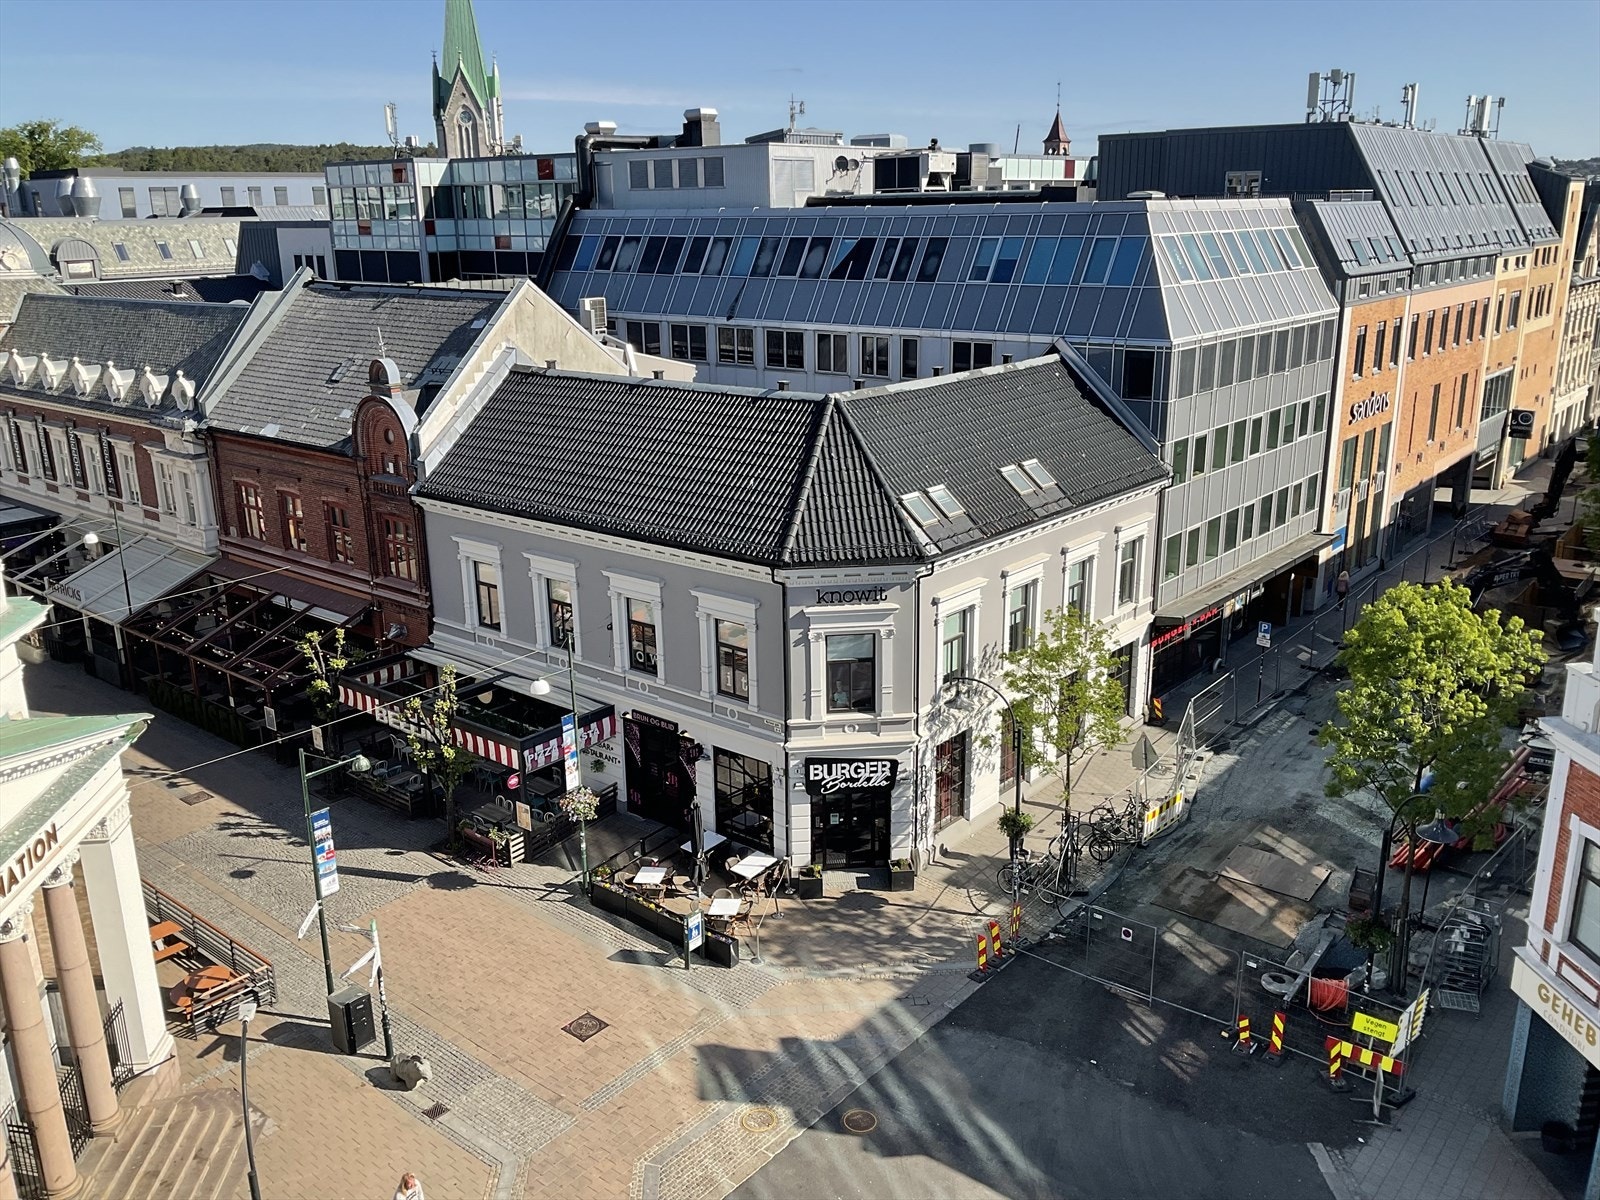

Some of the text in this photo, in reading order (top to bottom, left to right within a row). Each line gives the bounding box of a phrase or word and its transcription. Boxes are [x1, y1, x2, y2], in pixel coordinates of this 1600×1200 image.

[67, 427, 82, 477] SHOPPING
[99, 432, 115, 484] SHOPPING
[816, 586, 888, 604] knowit
[633, 712, 649, 722] BRUN
[650, 718, 660, 726] OG
[527, 745, 557, 762] PIZZA
[809, 761, 891, 780] BURGER
[821, 771, 890, 794] Bordello
[1365, 1017, 1387, 1030] Vegen
[1537, 983, 1597, 1047] GEHEB
[1363, 1026, 1385, 1038] stengt
